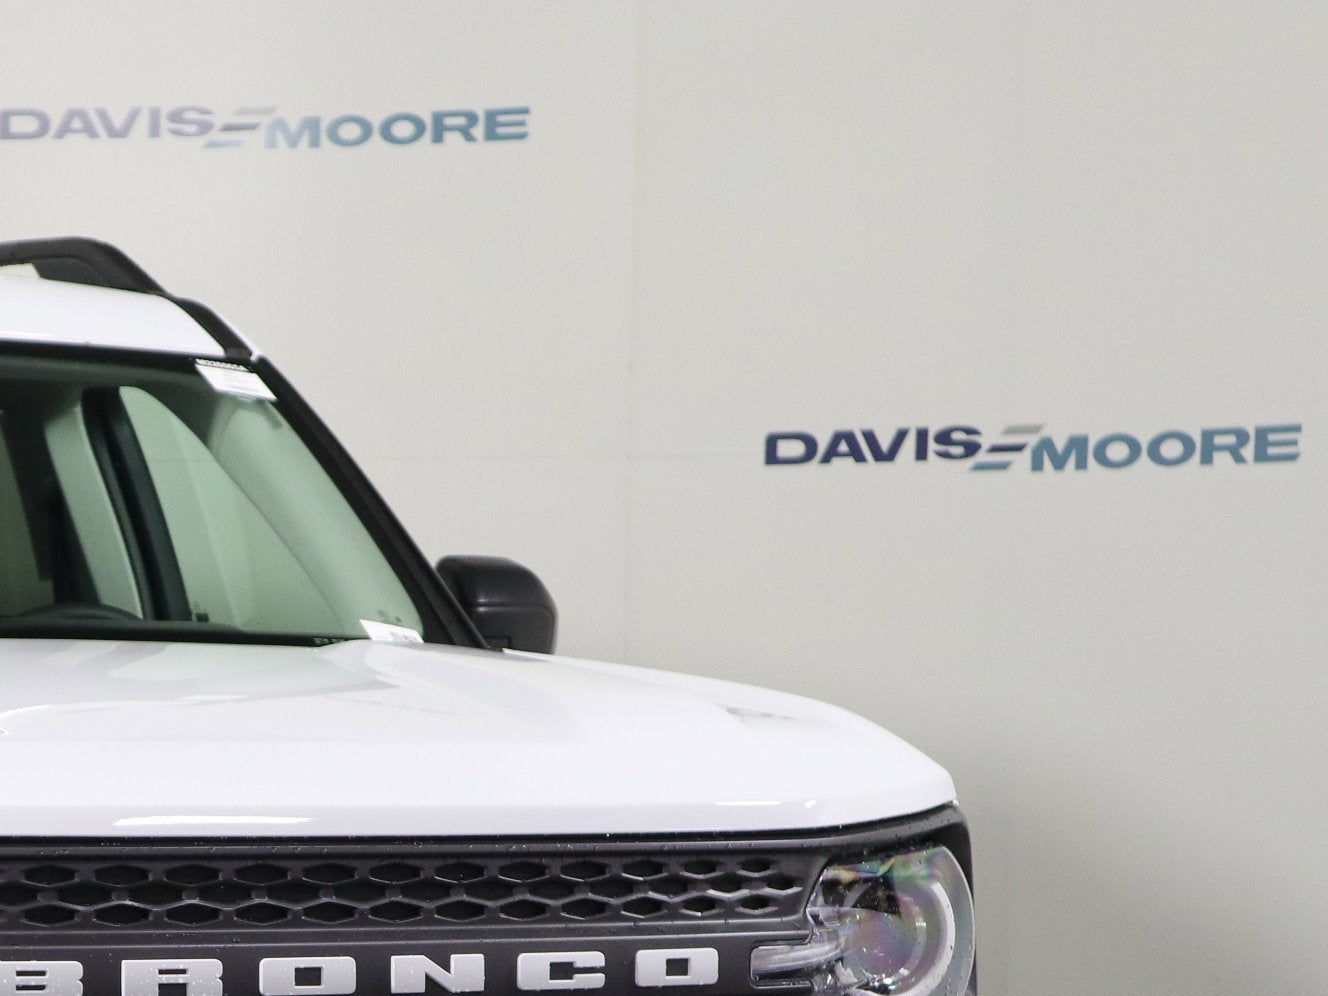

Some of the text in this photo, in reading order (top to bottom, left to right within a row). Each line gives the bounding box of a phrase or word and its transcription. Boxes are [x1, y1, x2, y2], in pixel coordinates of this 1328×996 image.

[265, 106, 530, 149] MOORE
[763, 423, 1302, 472] DAVIS MOORE
